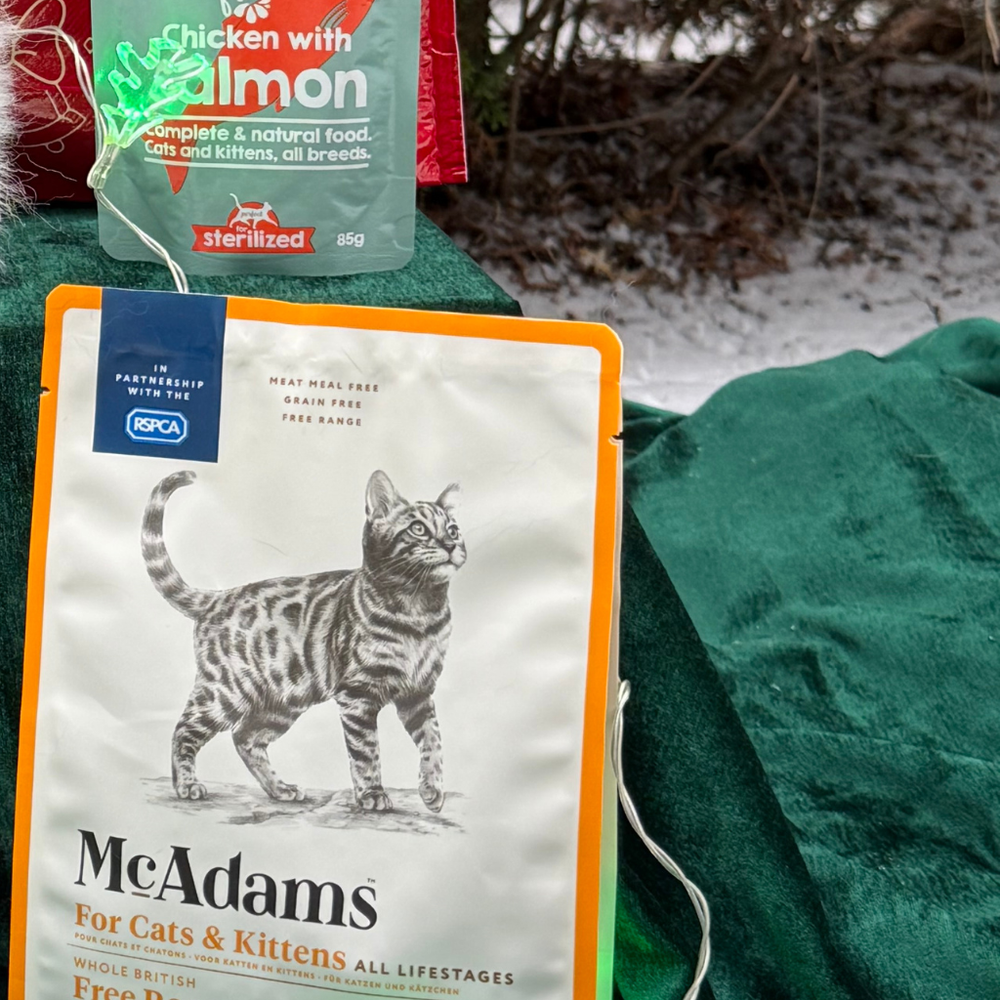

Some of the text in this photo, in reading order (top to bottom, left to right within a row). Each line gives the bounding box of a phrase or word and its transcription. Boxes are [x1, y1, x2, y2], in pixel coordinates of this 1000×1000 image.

[161, 23, 351, 52] Chicken with
[233, 126, 246, 141] &
[251, 127, 320, 143] natural
[325, 126, 372, 143] food.
[145, 139, 371, 162] Cats and kittens, all breeds.
[203, 229, 305, 248] sterilized
[336, 232, 365, 247] 85g
[153, 364, 167, 373] IN
[115, 373, 204, 389] PARTNERSHIP
[269, 377, 379, 393] MEAT MEAL FREE
[128, 387, 190, 400] WITH THE
[284, 396, 362, 409] GRAIN FREE
[133, 416, 181, 435] RSPCA
[282, 413, 362, 427] FREE RANGE
[74, 829, 377, 930] McAdams
[74, 902, 515, 985] For Cats & Kittens ALL LIFESTAGES
[73, 956, 196, 989] WHOLE BRITISH
[74, 932, 460, 996] POUR CHATS ET CHATONS VOOR KATTEN EN KITTENS FÜR KATZEN UND KÄTZCHEN
